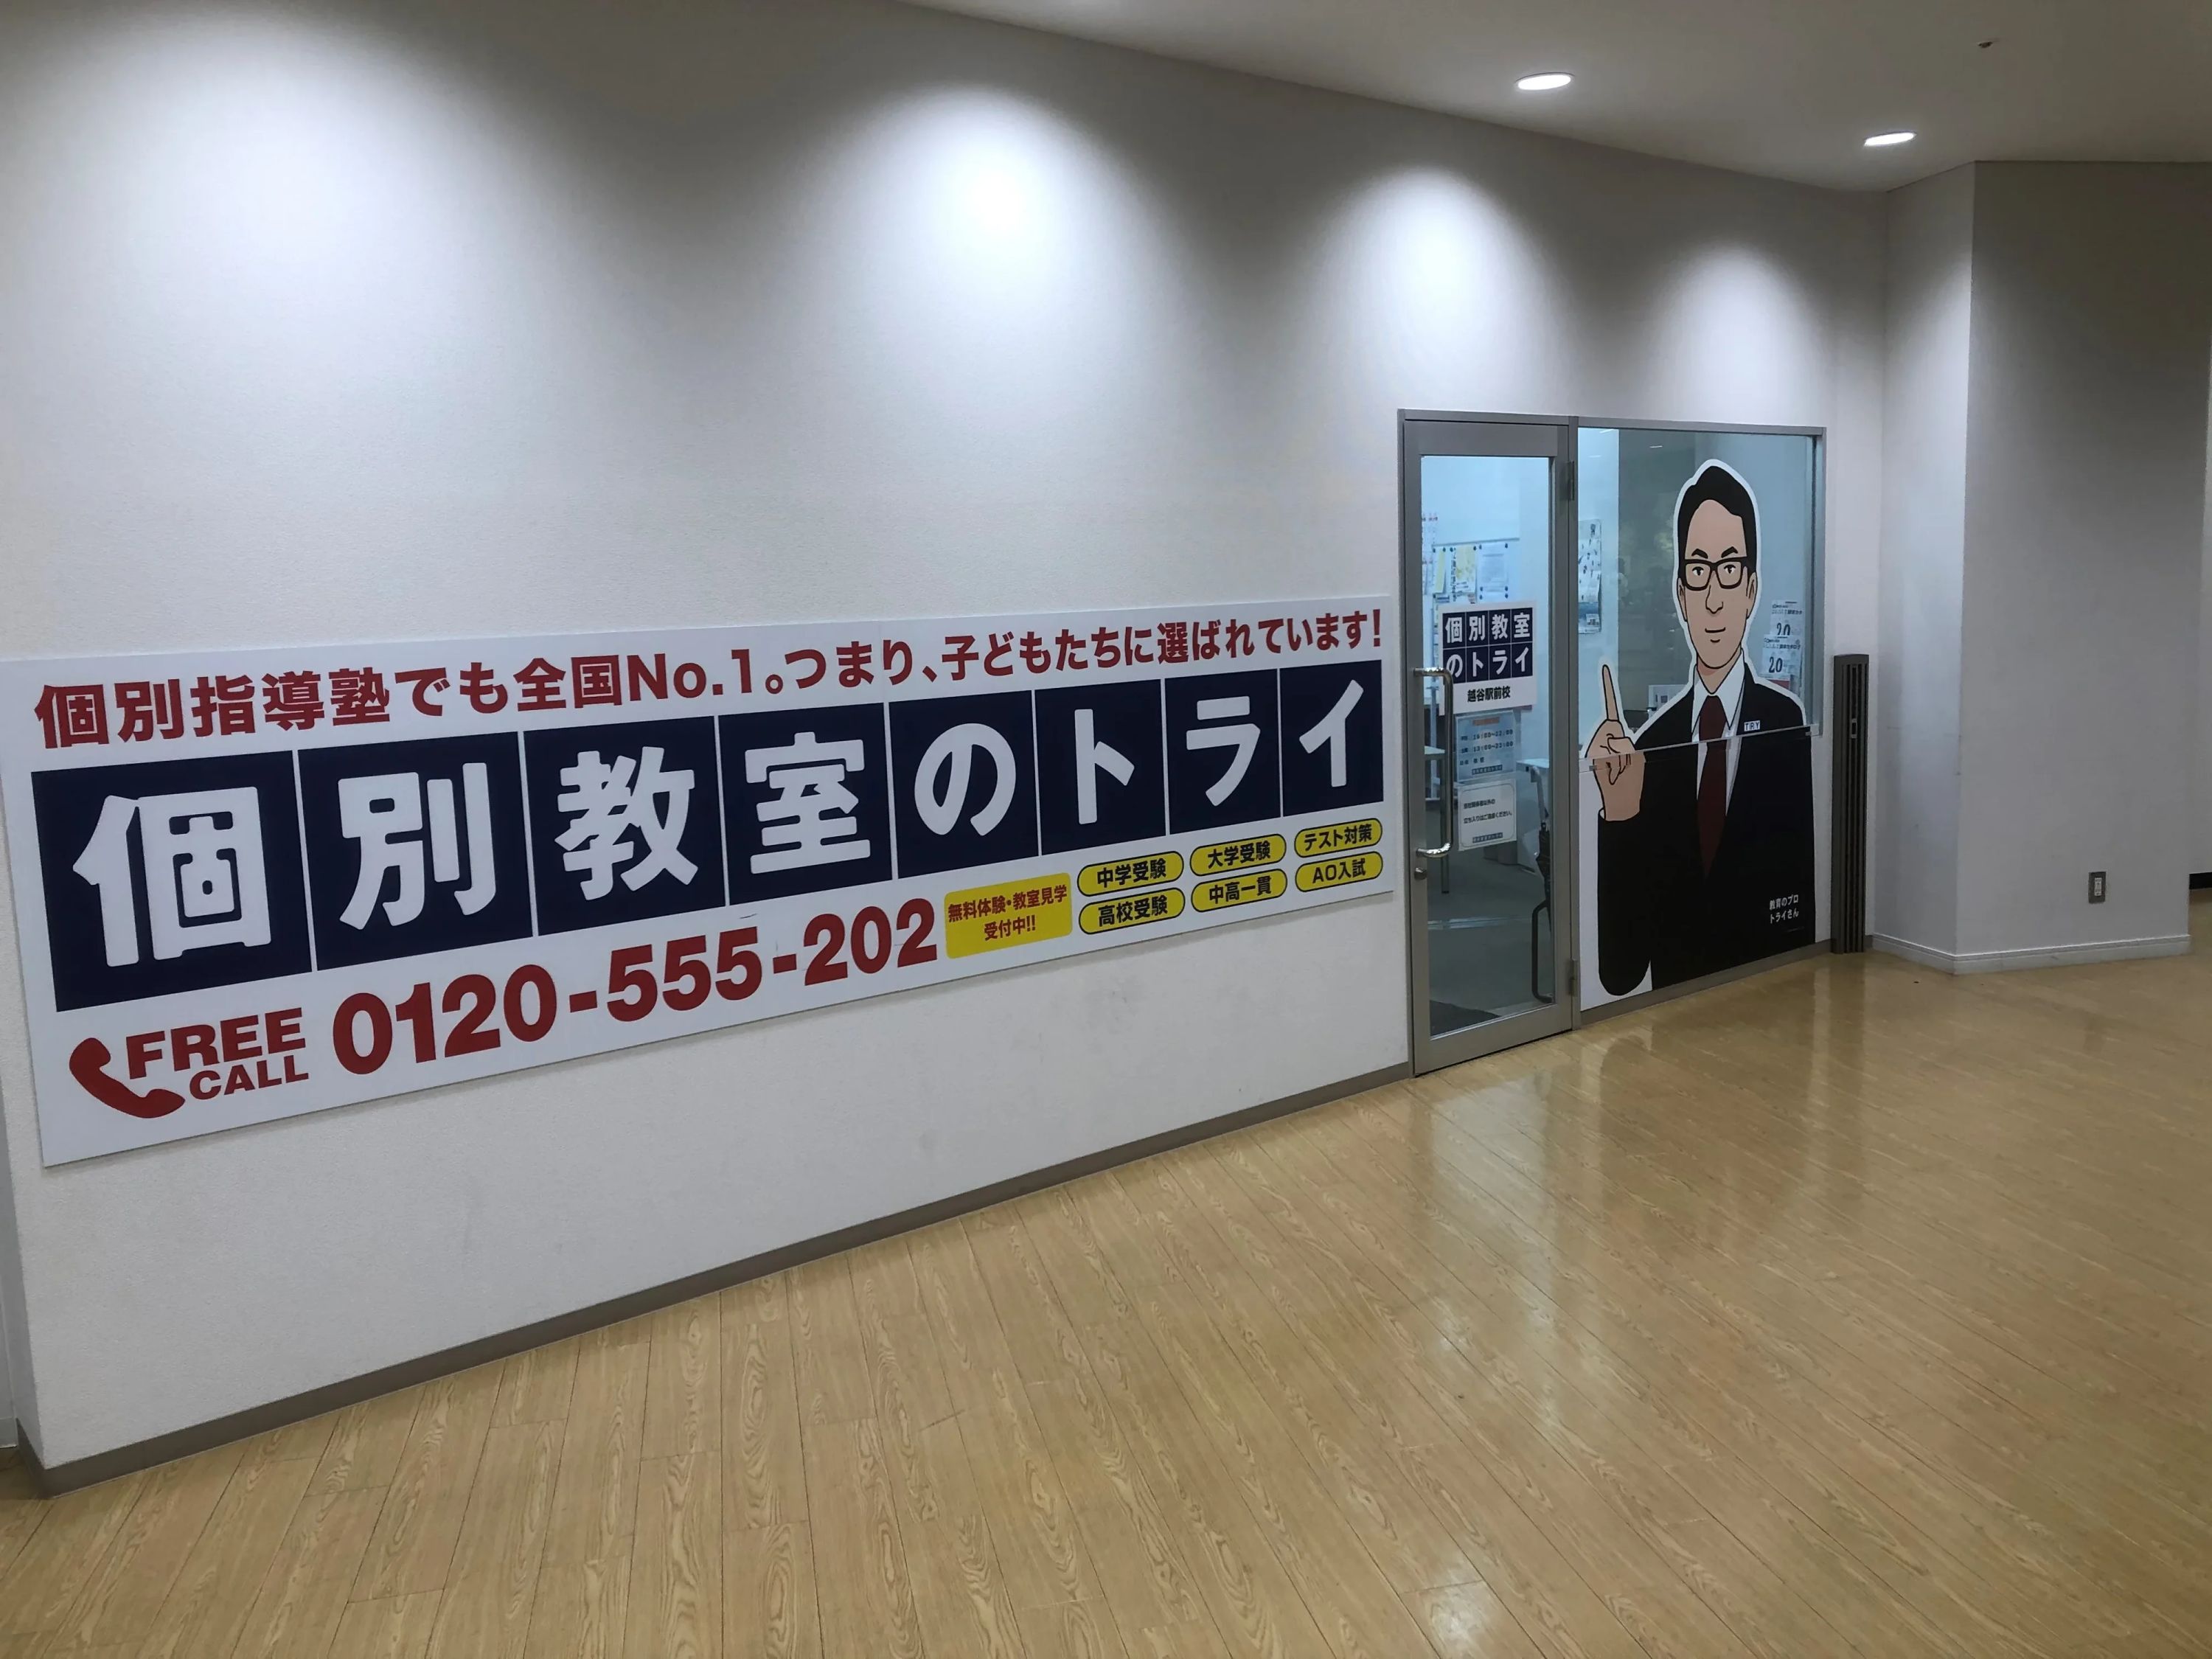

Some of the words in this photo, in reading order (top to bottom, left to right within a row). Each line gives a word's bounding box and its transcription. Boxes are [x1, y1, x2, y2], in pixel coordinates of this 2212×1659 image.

[1444, 612, 1531, 644] 個別教室
[1446, 646, 1529, 678] のトライ
[1768, 656, 1783, 673] 20
[1467, 686, 1511, 703] 越谷駅前校
[1745, 722, 1759, 731] TRY
[72, 680, 1364, 967] 個別教室のトライ
[1304, 823, 1372, 849] テスト対策
[1207, 843, 1271, 869] 大学受験
[1096, 862, 1167, 888] 中学受験
[1312, 858, 1367, 883] AO入試
[1208, 874, 1272, 902] 中高一貫
[947, 886, 1068, 922] 無料体験・教室見学
[1097, 899, 1168, 927] 高校受験
[1770, 894, 1799, 911] 教育のプロ
[1770, 908, 1799, 924] トライさん
[984, 917, 1037, 942] 受付中!!
[332, 897, 938, 1076] 0120-555-202
[125, 1007, 307, 1079] FREE
[189, 1055, 309, 1101] CALL
